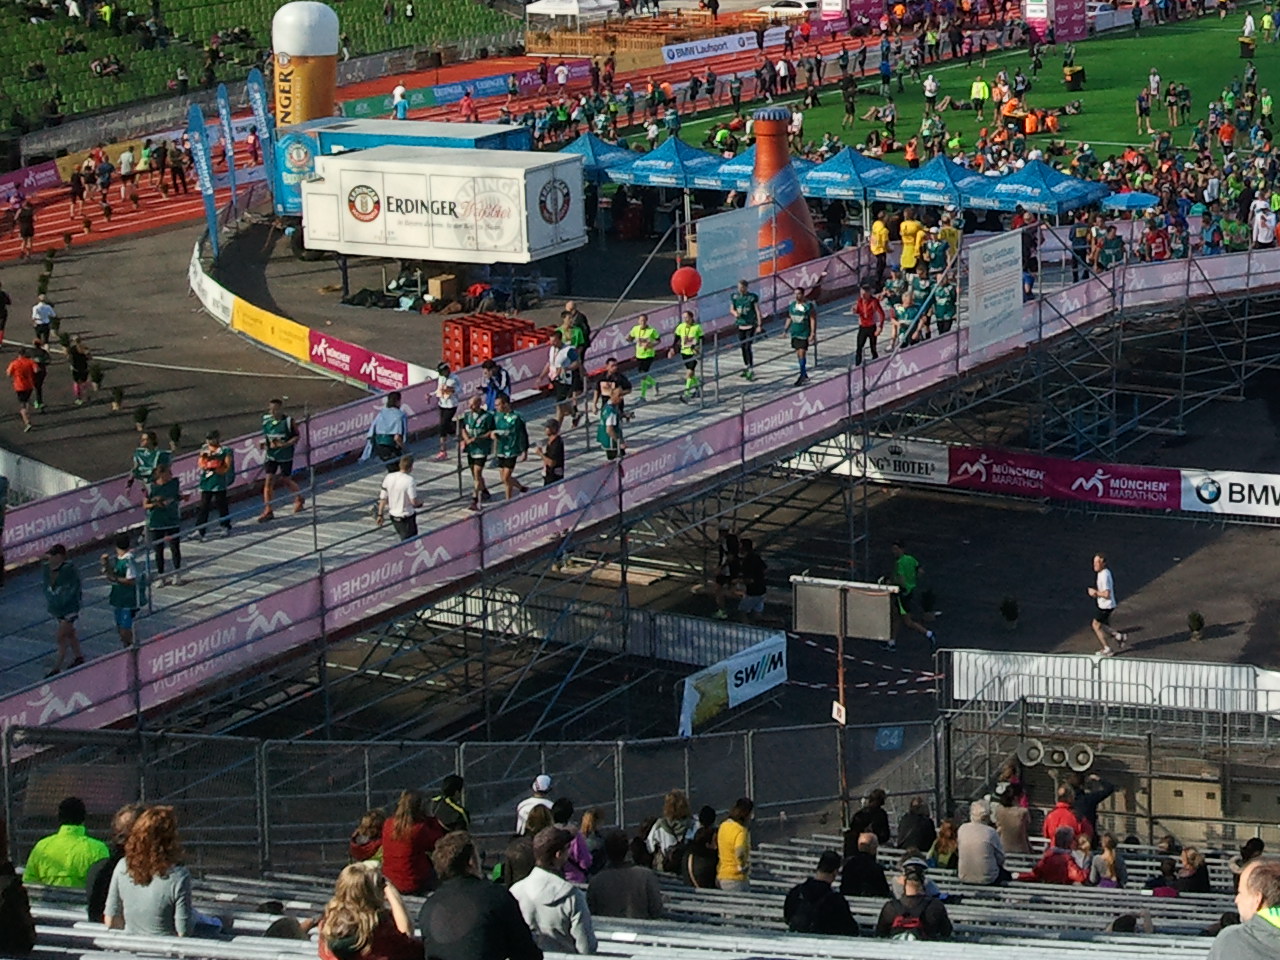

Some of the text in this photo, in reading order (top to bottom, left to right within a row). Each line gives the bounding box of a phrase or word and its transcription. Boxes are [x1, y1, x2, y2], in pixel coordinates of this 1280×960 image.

[676, 41, 728, 58] BMW Laufsport
[386, 195, 459, 219] ERDINGER
[992, 463, 1045, 480] MÜNCHEN
[992, 474, 1044, 489] MARATHON
[1110, 476, 1167, 492] MÜNCHEN
[1110, 489, 1167, 502] MARATHON
